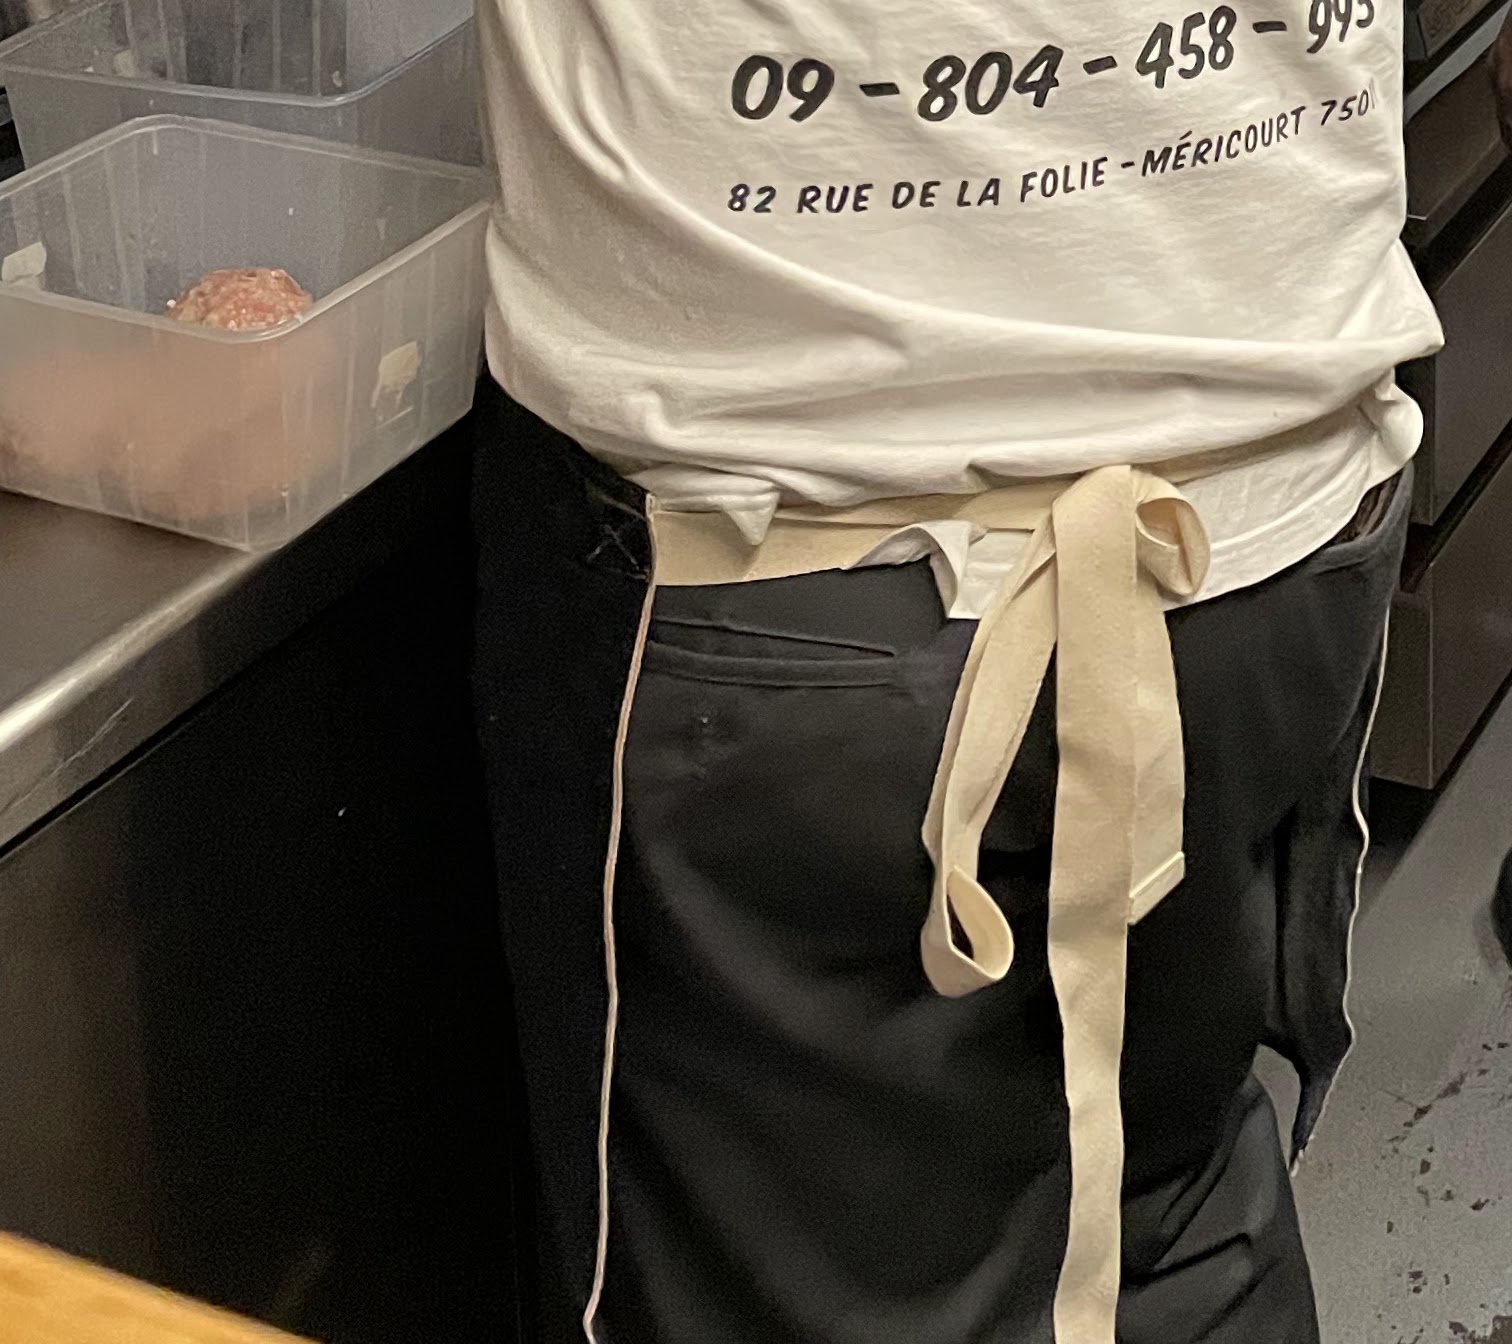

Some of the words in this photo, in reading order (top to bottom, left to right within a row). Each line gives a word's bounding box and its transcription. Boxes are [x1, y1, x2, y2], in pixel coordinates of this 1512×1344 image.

[727, 183, 777, 213] 82
[796, 183, 874, 213] RUE
[891, 181, 936, 208] DE
[958, 177, 1001, 207] LA
